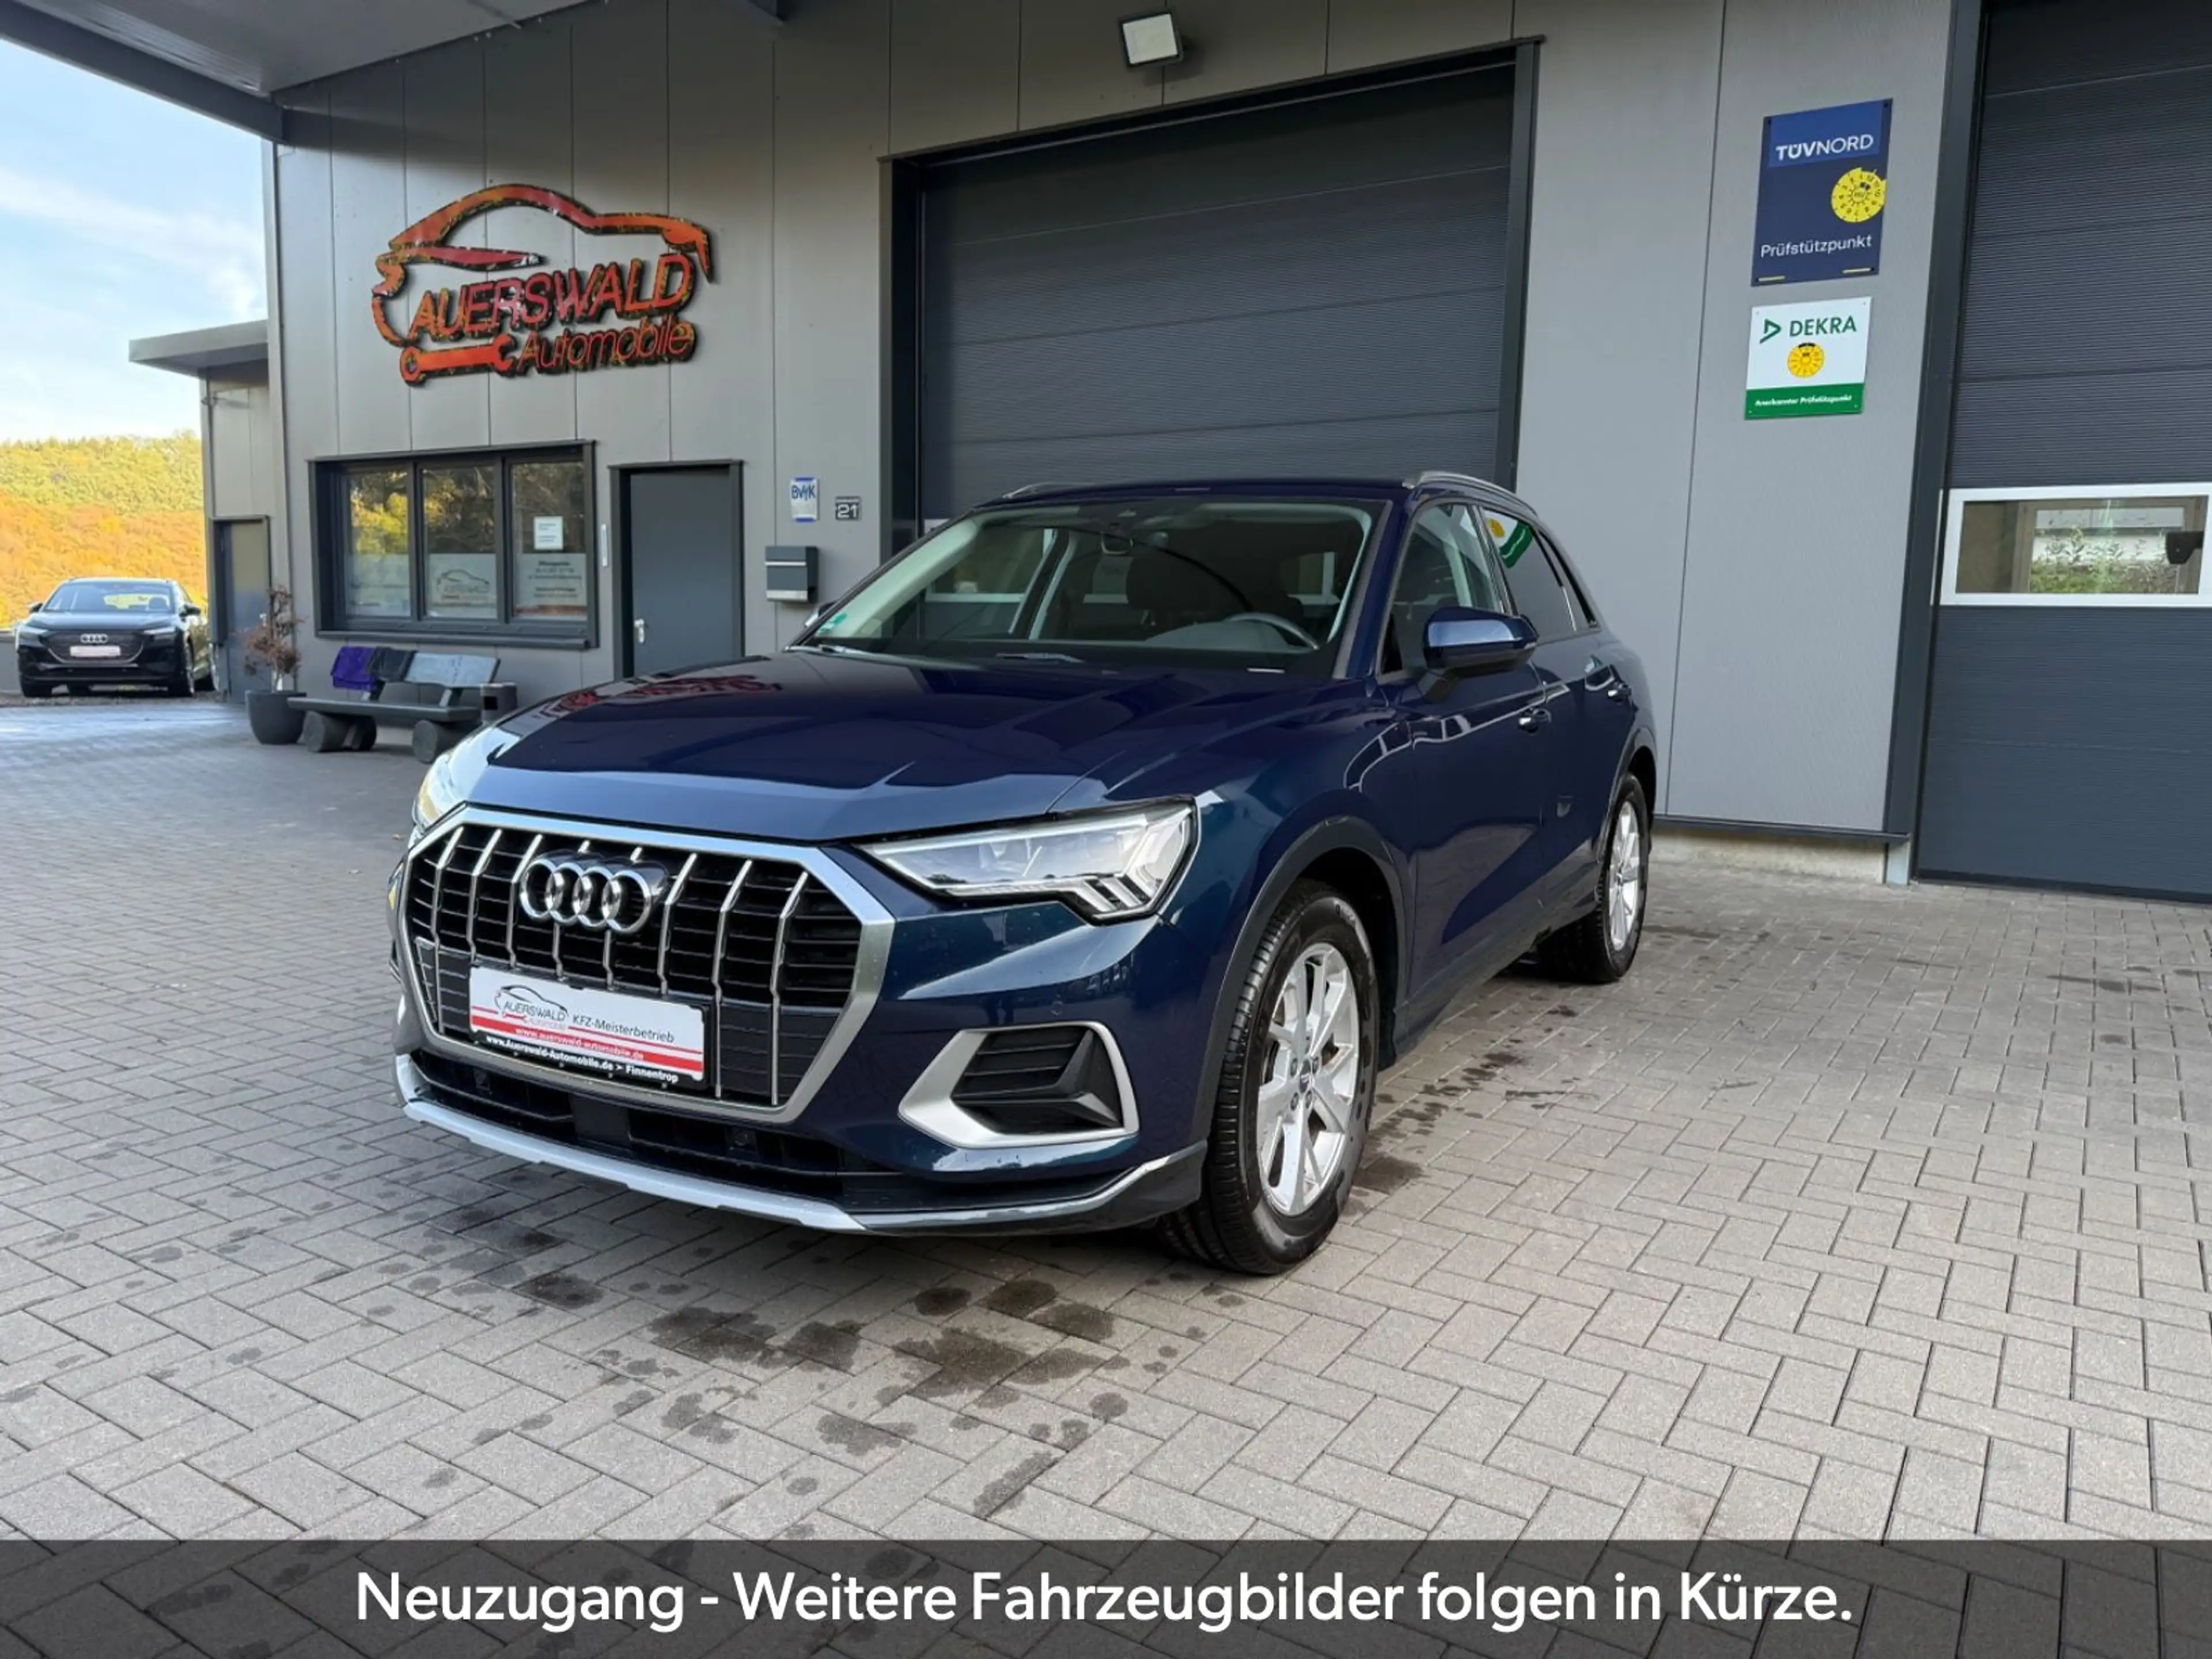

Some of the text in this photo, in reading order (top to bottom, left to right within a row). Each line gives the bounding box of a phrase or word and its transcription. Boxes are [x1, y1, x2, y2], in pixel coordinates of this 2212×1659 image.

[1760, 234, 1873, 258] Prüfstützpunkt
[408, 252, 695, 341] AUERSWALD
[1789, 315, 1857, 337] DEKRA
[517, 315, 696, 374] Automobile
[837, 503, 857, 518] 21
[503, 1001, 566, 1021] AUERSWALD
[572, 1014, 675, 1043] KFZ-Meisterbetrieb
[625, 1064, 679, 1084] Finnentrop
